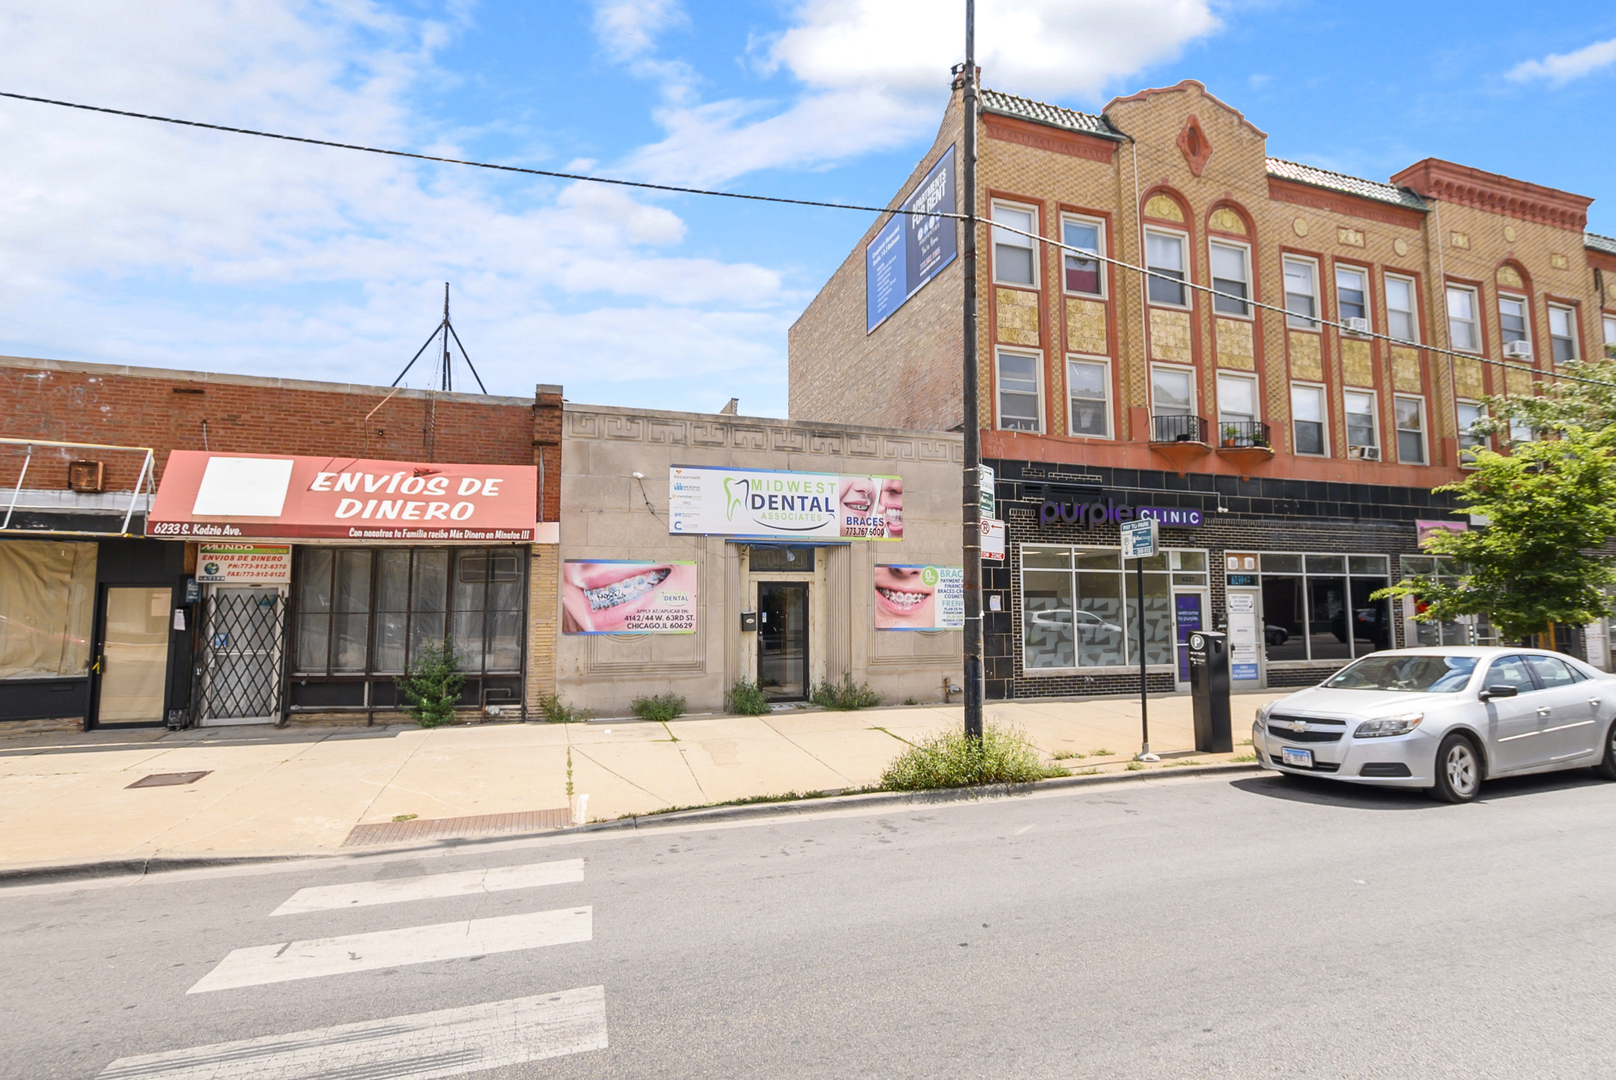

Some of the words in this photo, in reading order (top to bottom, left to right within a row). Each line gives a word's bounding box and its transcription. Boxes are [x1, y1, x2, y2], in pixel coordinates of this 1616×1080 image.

[913, 168, 946, 212] APARTMENTS
[912, 204, 926, 229] FOR
[927, 179, 946, 213] RENT
[310, 471, 449, 496] ENVÍOS
[457, 477, 504, 496] DE
[751, 479, 837, 494] MIDWEST
[334, 498, 475, 521] DINERO
[751, 494, 835, 513] DENTAL
[761, 512, 822, 522] ASSOCIATES
[1040, 497, 1134, 530] purple
[1140, 509, 1199, 525] CLINIC
[153, 522, 181, 535] 6233
[181, 523, 191, 535] S.
[192, 524, 222, 536] Kedzie
[222, 525, 242, 536] Ave.
[846, 516, 885, 527] BRACES
[348, 527, 363, 537] Con
[363, 529, 393, 538] nosotros
[394, 528, 401, 538] tu
[402, 528, 427, 538] Familia
[428, 529, 448, 539] recibe
[449, 528, 463, 539] Más
[464, 529, 485, 539] Dinero
[485, 531, 494, 539] en
[494, 529, 520, 540] Minutos
[845, 527, 885, 537] 773.767.6000
[940, 569, 963, 578] BRAC
